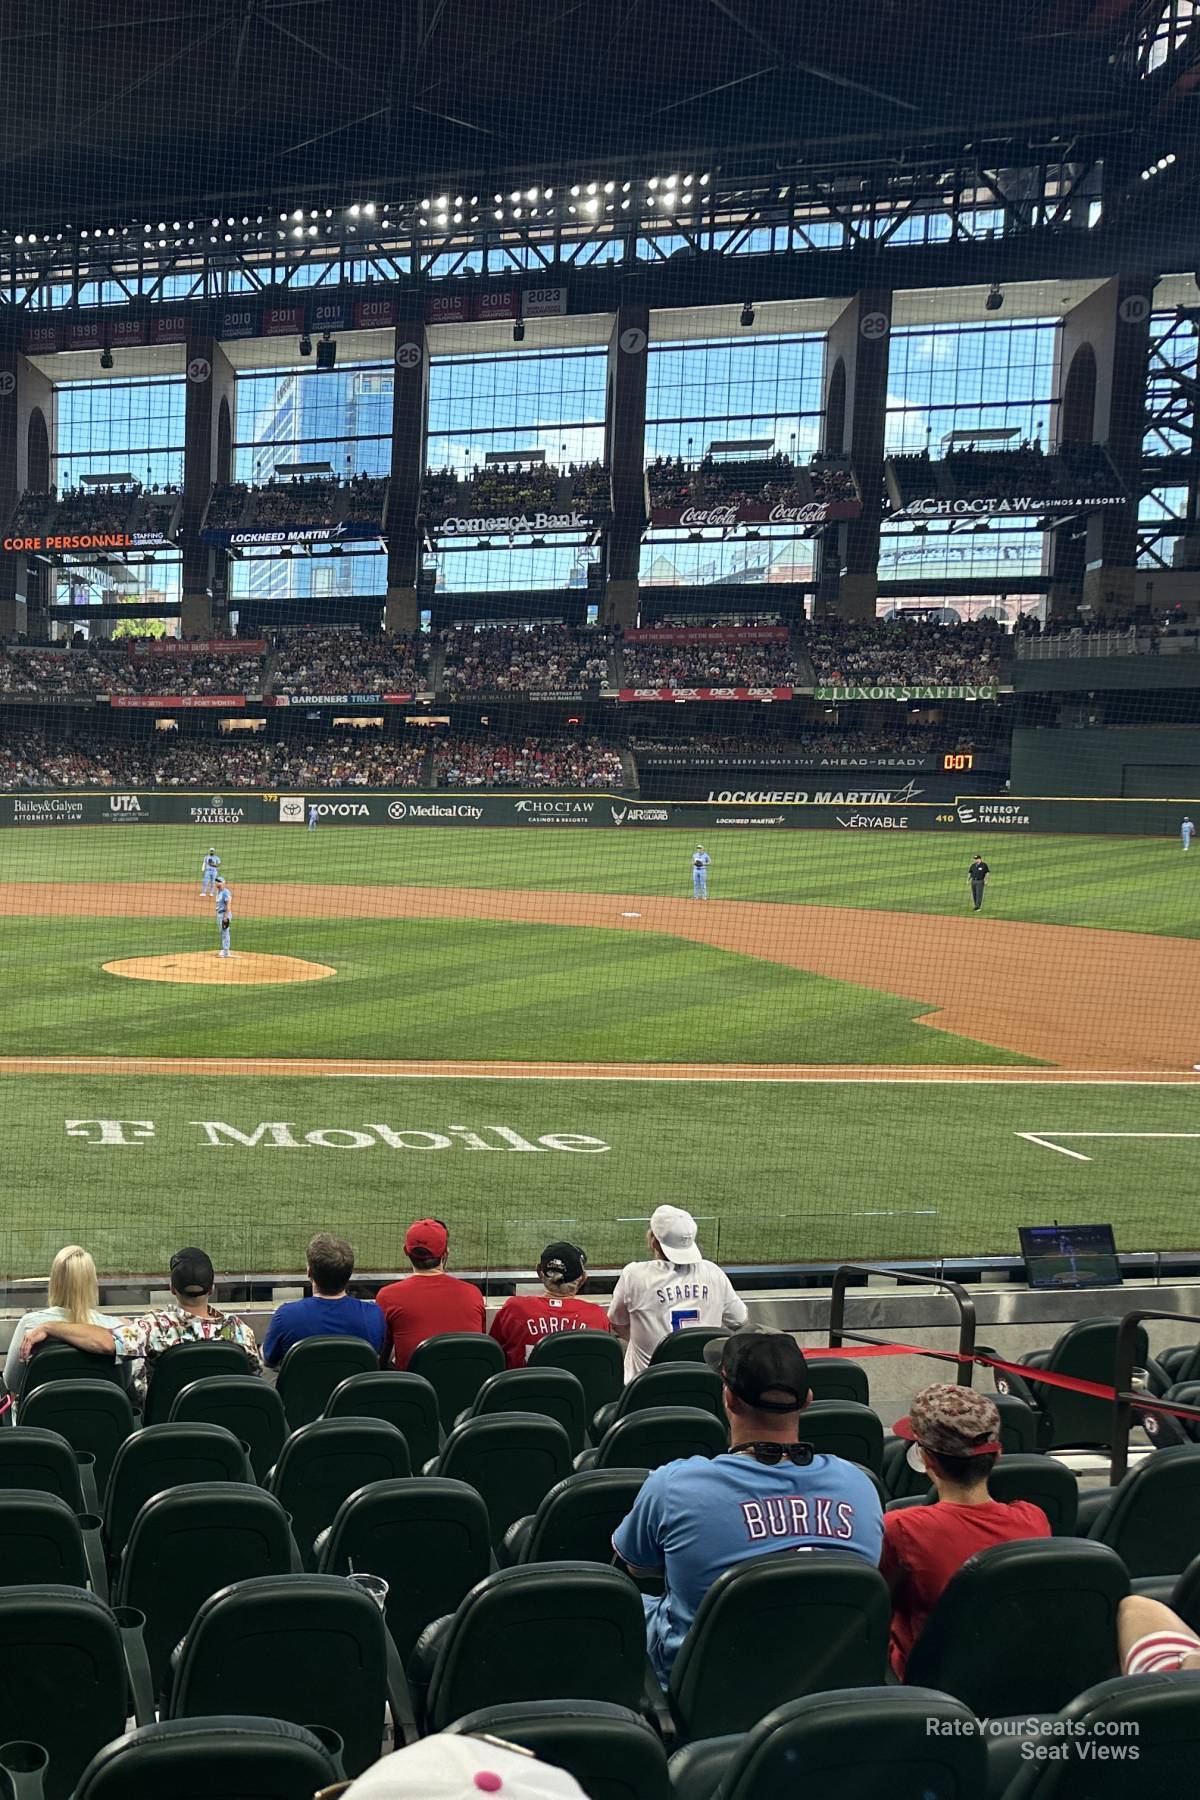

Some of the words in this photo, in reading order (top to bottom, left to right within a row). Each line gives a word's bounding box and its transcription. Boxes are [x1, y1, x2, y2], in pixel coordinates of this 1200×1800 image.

[433, 296, 462, 310] 2015
[482, 293, 511, 305] 2016
[528, 290, 561, 303] 2023
[316, 305, 341, 319] 2011
[363, 302, 391, 315] 2012
[1125, 302, 1143, 317] 10
[224, 312, 251, 326] 2010
[271, 310, 296, 322] 2011
[72, 324, 98, 337] 1998
[114, 321, 140, 333] 1999
[158, 318, 185, 331] 2010
[864, 318, 886, 333] 29
[30, 328, 55, 341] 1996
[627, 333, 639, 349] 7
[400, 350, 418, 363] 26
[190, 363, 209, 377] 34
[0, 376, 13, 390] 42
[919, 497, 1033, 514] CHOCTAW
[1084, 497, 1127, 505] RESORTS
[533, 512, 585, 528] Bank
[4, 538, 41, 550] CORE
[46, 534, 133, 549] PERSONNEL
[230, 532, 284, 543] LOCKHEED
[285, 529, 331, 541] MARTIN
[634, 688, 660, 697] DEX
[672, 688, 699, 697] DEX
[709, 688, 736, 697] DEX
[748, 687, 775, 696] DEX
[832, 686, 895, 700] LUXOR
[900, 686, 993, 700] STAFFING
[292, 695, 348, 704] GARDENERS
[351, 694, 381, 703] TRUST
[820, 758, 926, 766] AHEAD-READY
[943, 754, 973, 769] 0:07
[110, 796, 141, 811] UTA
[708, 791, 809, 804] LOCKHEED
[814, 791, 891, 804] MARTIN
[190, 807, 244, 816] ESTRELLA
[409, 805, 457, 817] Medical
[458, 805, 484, 820] City
[522, 800, 595, 812] CHOCTAW
[979, 805, 1020, 814] ENERGY
[195, 815, 240, 823] JALISCO
[628, 809, 643, 820] AIR
[978, 815, 1030, 824] TRANSFER
[65, 1119, 155, 1145] T
[188, 1120, 613, 1153] Mobile
[656, 1284, 709, 1303] SEAGER
[740, 1496, 855, 1541] BURKS
